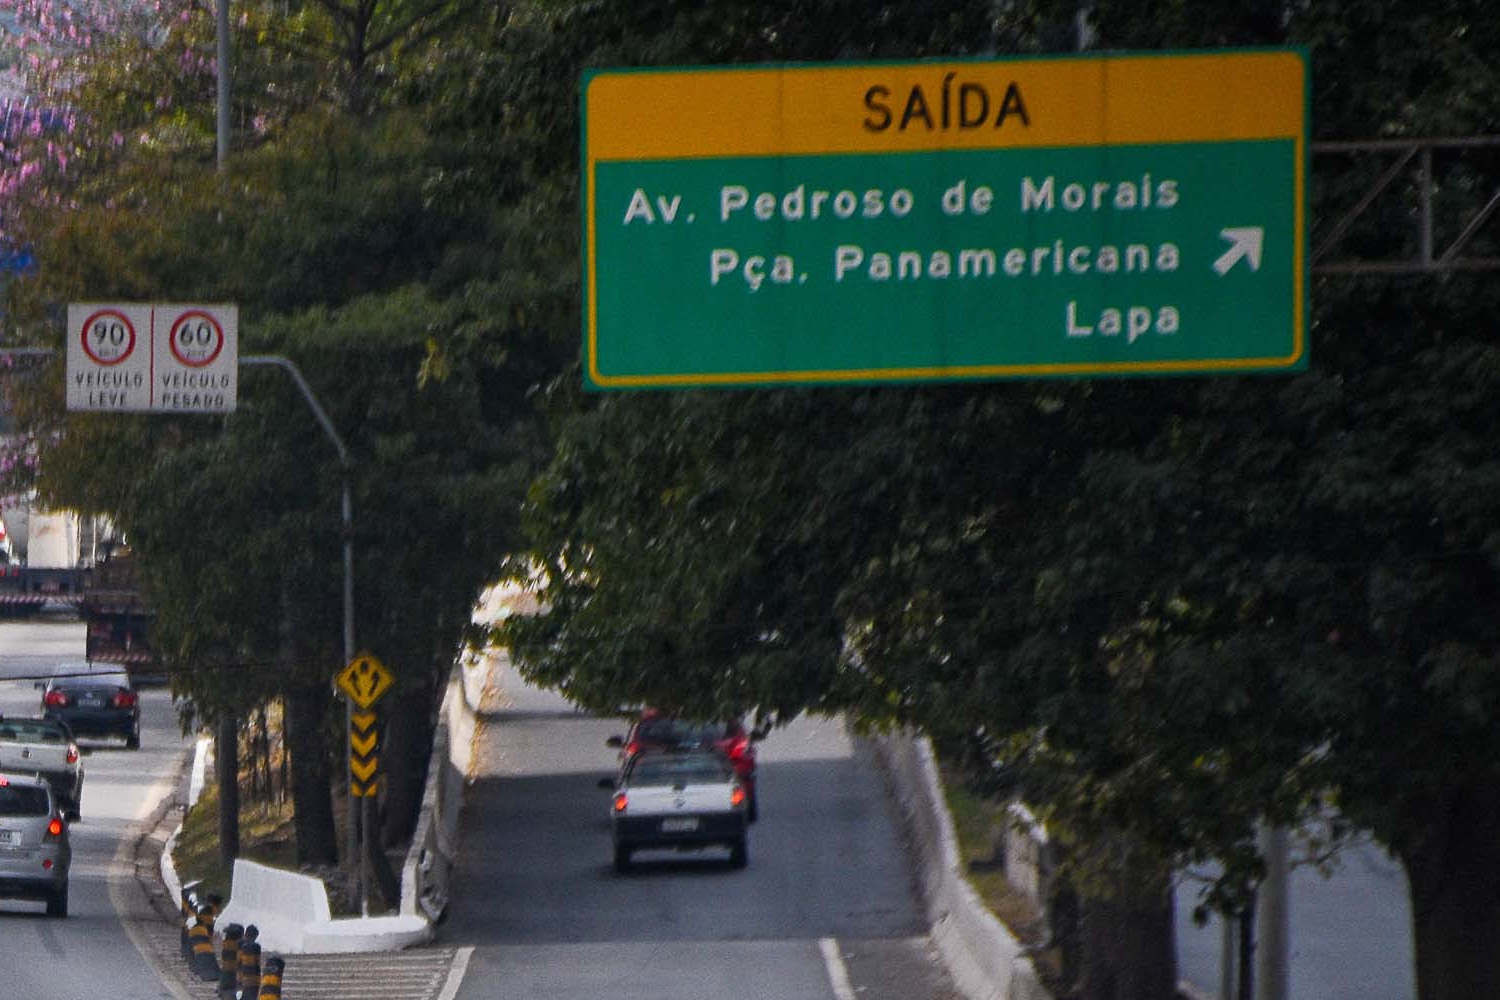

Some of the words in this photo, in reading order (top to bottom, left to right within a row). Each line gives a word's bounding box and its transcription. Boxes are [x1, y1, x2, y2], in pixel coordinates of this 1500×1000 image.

[863, 74, 1032, 133] SAÍDA
[624, 189, 696, 225] Av.
[720, 180, 914, 222] Pedroso
[943, 181, 995, 215] de
[1021, 174, 1181, 213] Morais
[710, 249, 809, 293] Pça.
[835, 239, 1181, 282] Panamericana
[94, 321, 125, 346] 90
[180, 321, 212, 347] 60
[1066, 302, 1181, 344] Lapa
[88, 392, 127, 407] LEVE
[162, 393, 224, 409] PESADO
